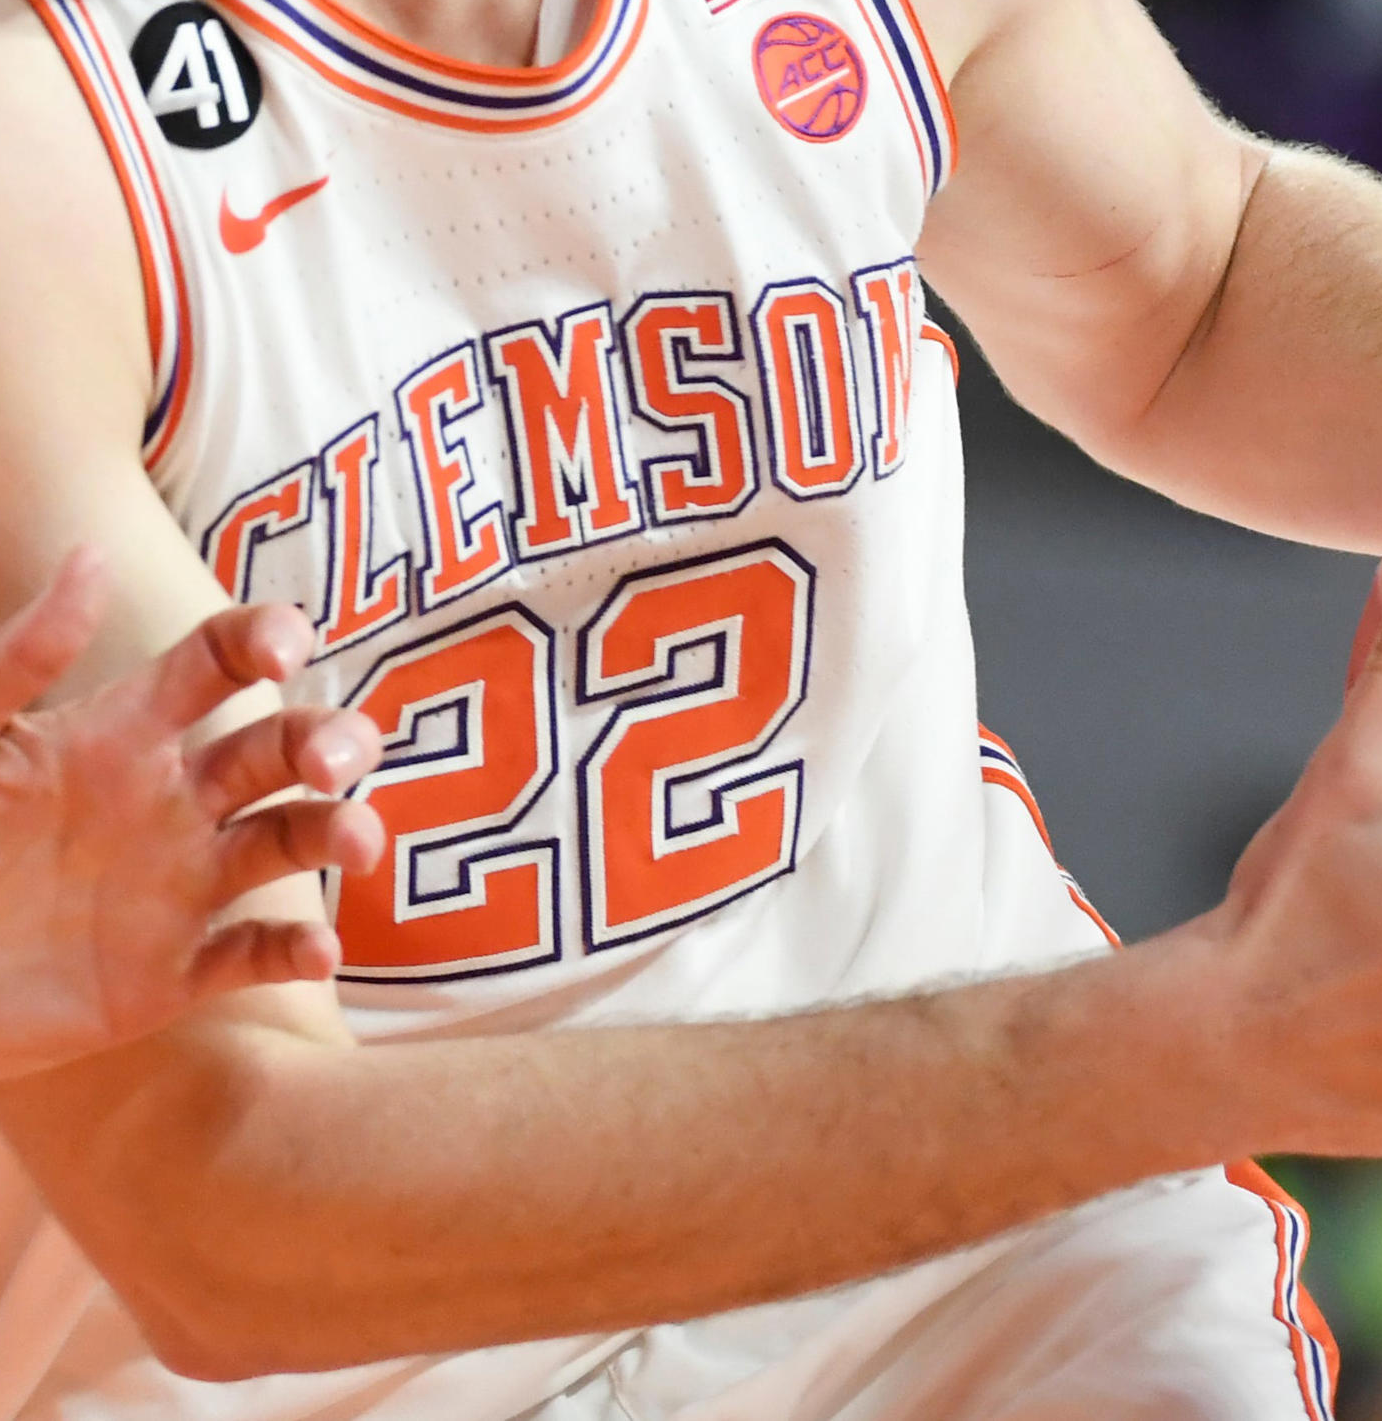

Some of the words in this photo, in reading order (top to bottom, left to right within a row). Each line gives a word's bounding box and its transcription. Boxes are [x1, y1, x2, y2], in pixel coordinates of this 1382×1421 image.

[146, 18, 250, 129] 41
[779, 36, 848, 93] ACC
[200, 255, 916, 668] CLEMSON
[319, 537, 817, 984] 22
